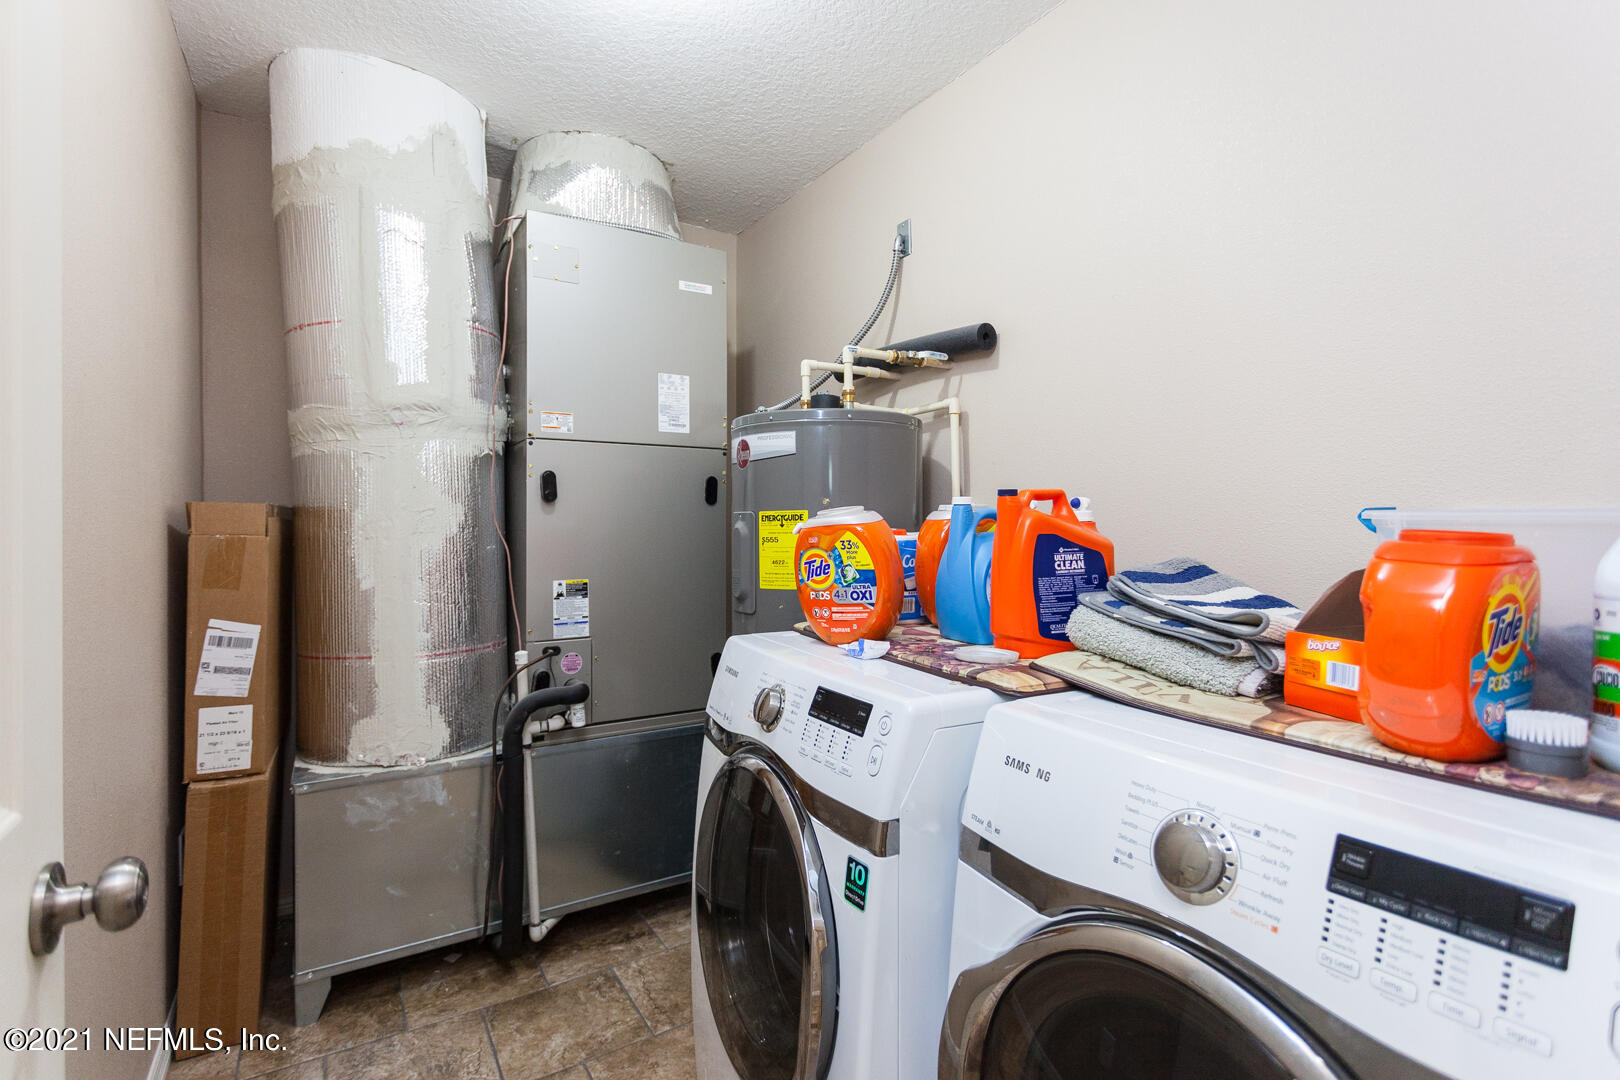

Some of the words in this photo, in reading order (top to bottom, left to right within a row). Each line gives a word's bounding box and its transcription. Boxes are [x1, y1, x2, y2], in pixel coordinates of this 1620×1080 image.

[840, 540, 859, 550] 33%
[1054, 553, 1084, 561] ULTIMATE
[803, 558, 831, 583] Tide
[1054, 560, 1085, 570] CLEAN
[850, 590, 873, 601] OXI
[1487, 603, 1524, 662] Tide
[1307, 638, 1341, 652] bounce
[849, 862, 866, 886] 10
